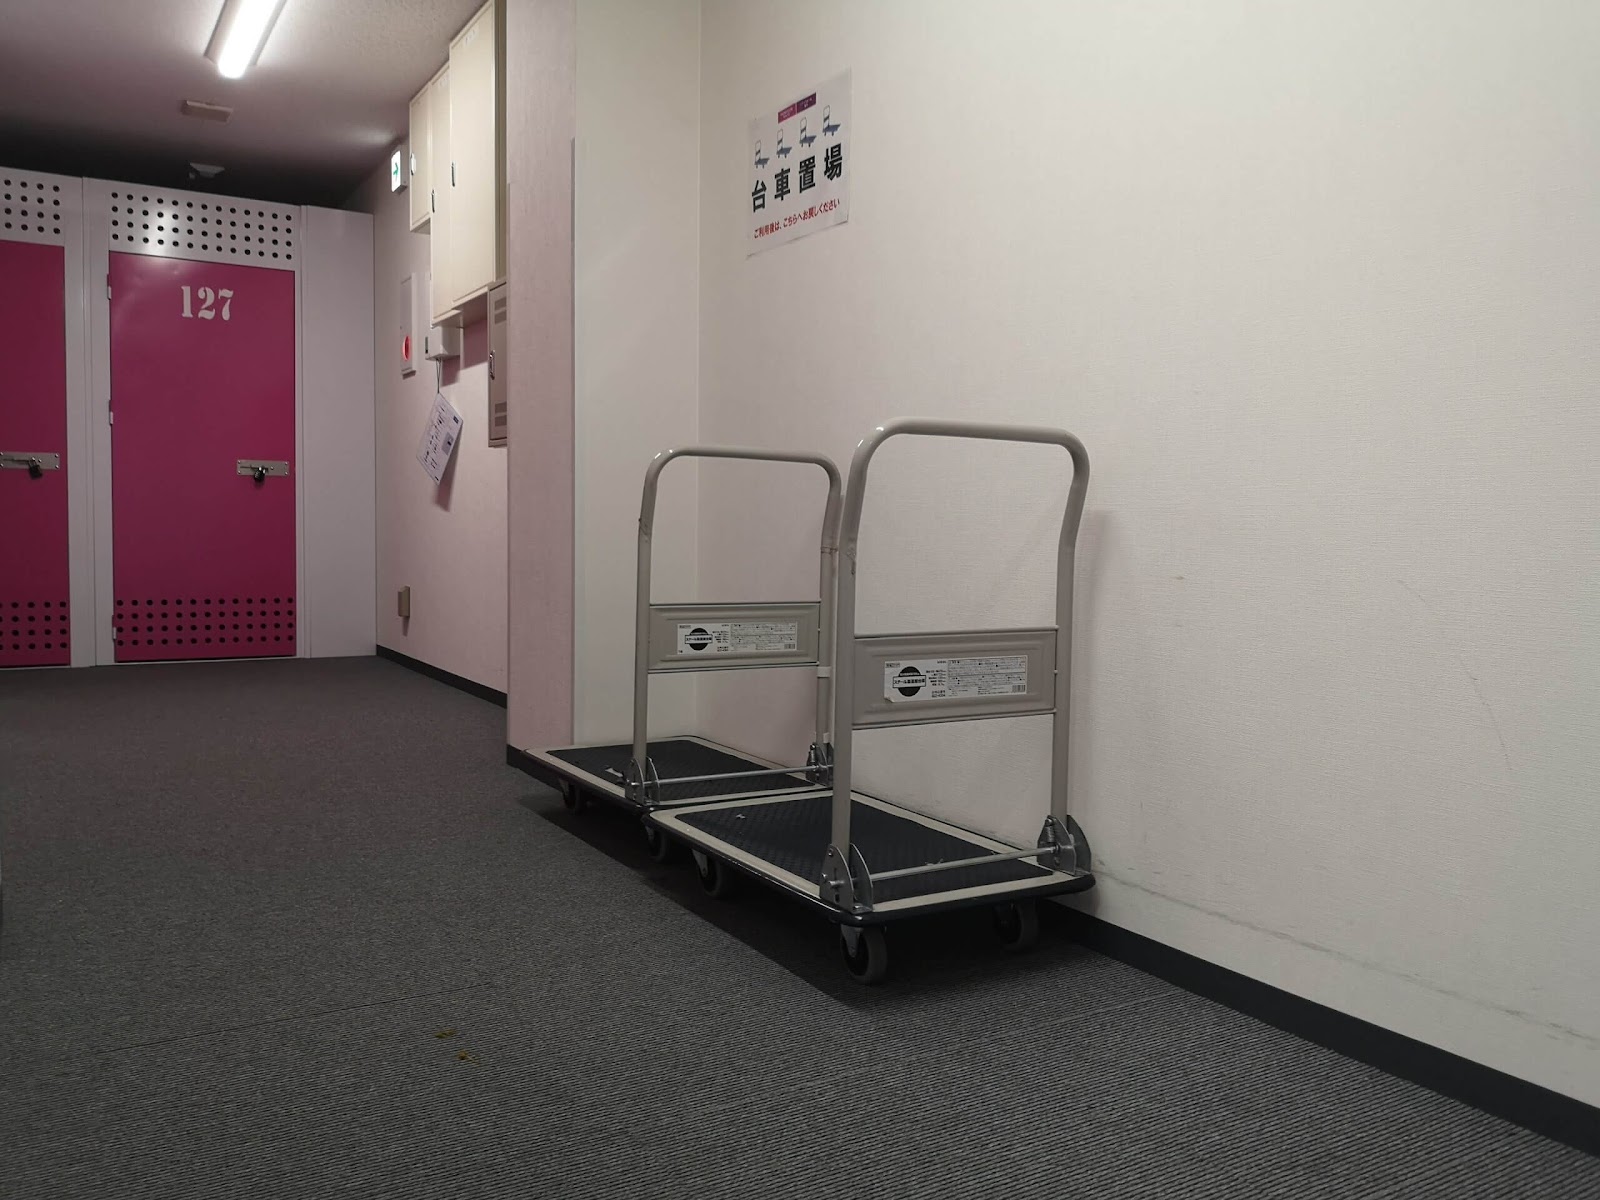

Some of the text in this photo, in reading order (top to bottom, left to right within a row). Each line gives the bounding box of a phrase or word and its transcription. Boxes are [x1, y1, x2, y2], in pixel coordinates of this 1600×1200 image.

[752, 142, 842, 213] 台車置場
[181, 286, 234, 321] 127
